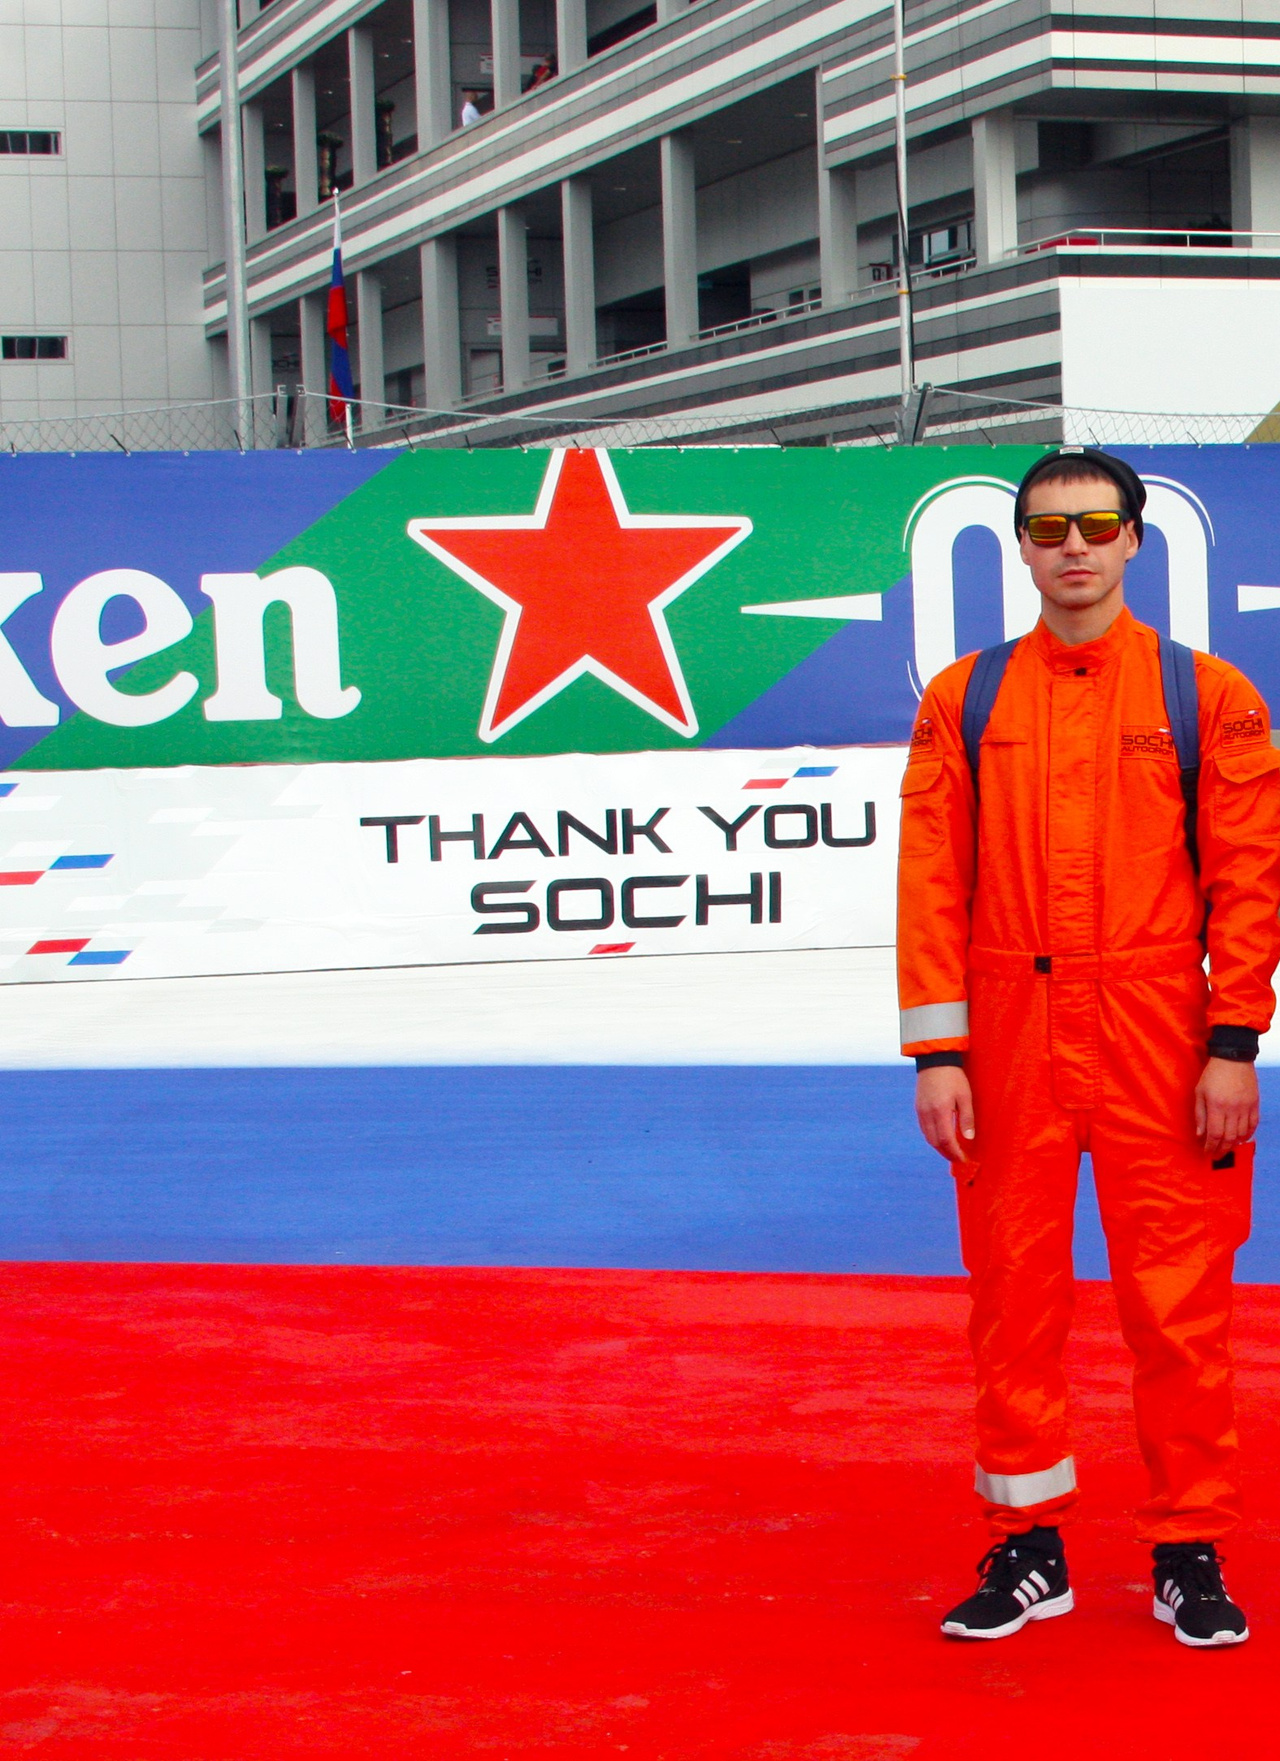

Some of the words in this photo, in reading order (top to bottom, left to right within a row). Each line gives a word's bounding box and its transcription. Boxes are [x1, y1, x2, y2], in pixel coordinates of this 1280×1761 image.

[1222, 717, 1264, 734] SOCHI
[360, 806, 671, 864] THANK
[696, 800, 877, 852] YOU
[470, 870, 783, 935] SOCHI
